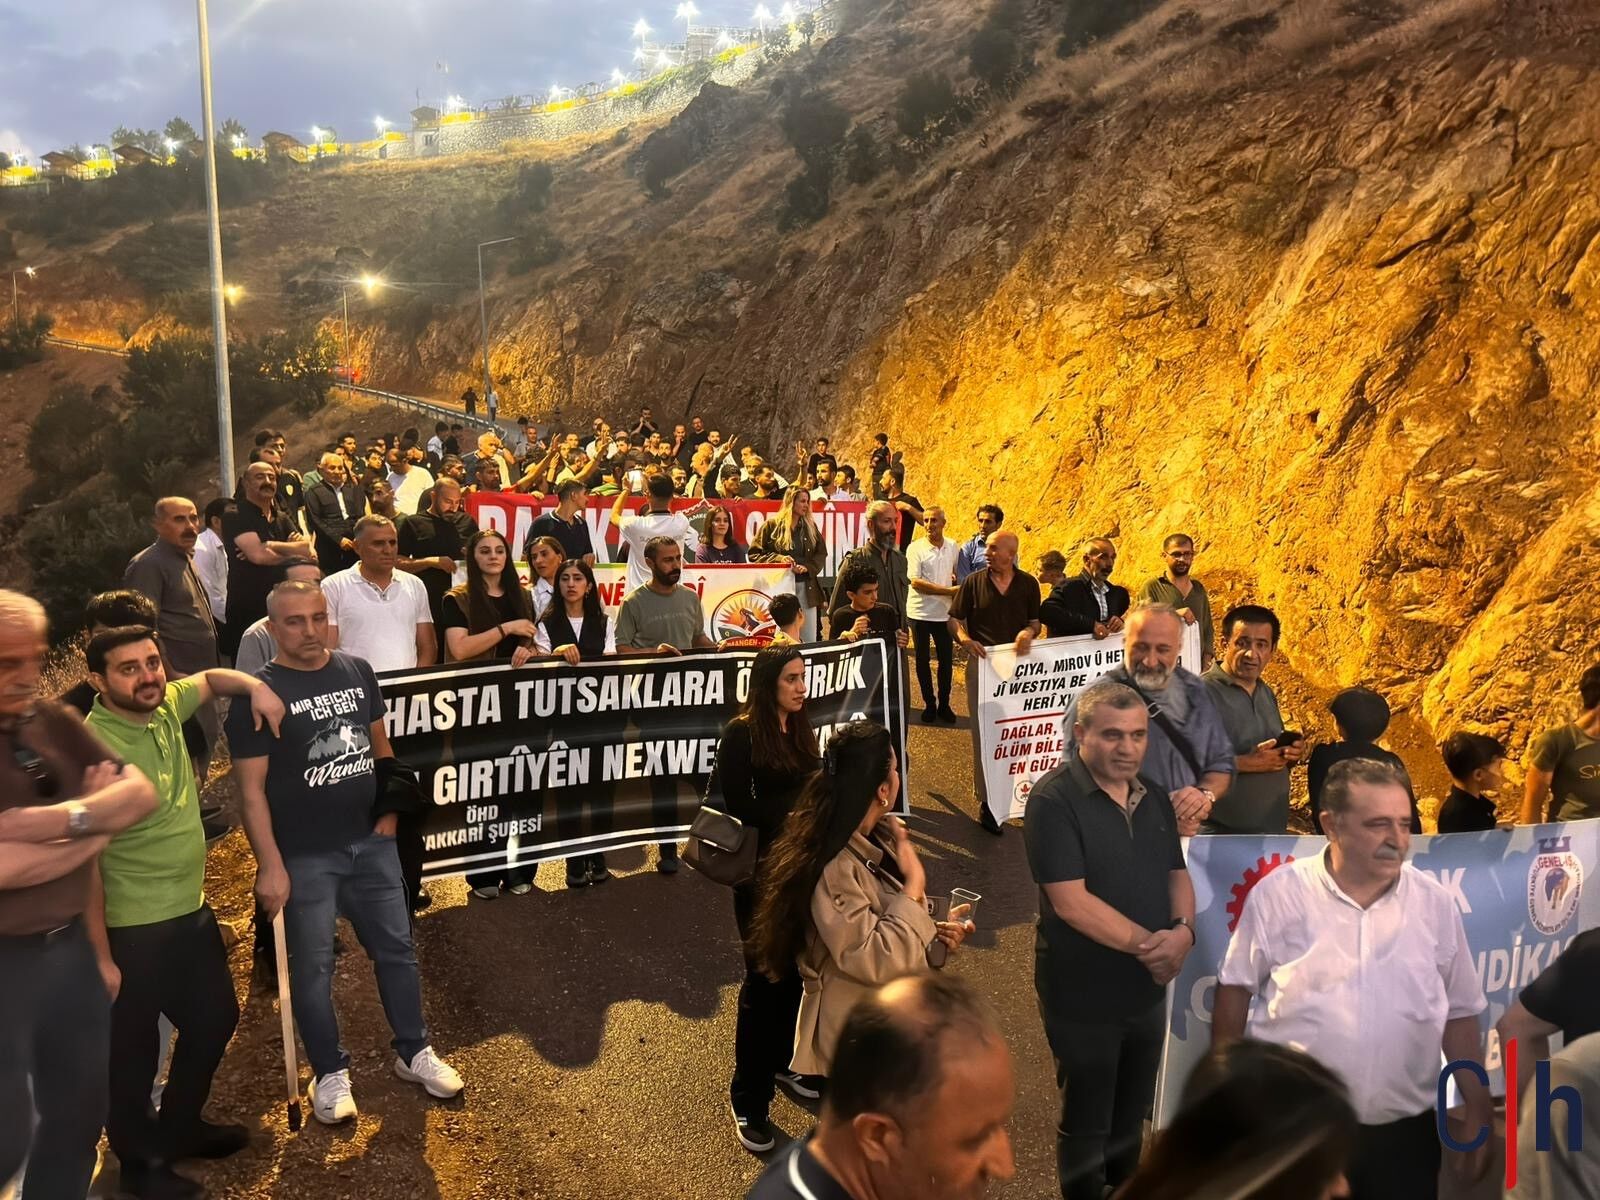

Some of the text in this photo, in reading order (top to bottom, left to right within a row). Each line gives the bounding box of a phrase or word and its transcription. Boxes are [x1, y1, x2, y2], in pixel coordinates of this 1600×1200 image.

[1015, 662, 1048, 679] ÇIYA,
[1053, 655, 1091, 672] MIROV
[1095, 650, 1102, 666] Û
[993, 681, 1007, 697] JÎ
[1009, 677, 1065, 695] WESTIYA
[290, 687, 365, 715] MIR REICHT'S
[310, 700, 358, 721] ICH GEH
[384, 683, 502, 738] HASTA
[515, 669, 725, 720] TUTSAKLARA
[1023, 693, 1057, 711] HERÎ
[1001, 722, 1057, 741] DAĞLAR,
[994, 737, 1064, 760] ÖLÜM BİLE
[433, 738, 721, 806] GIRTÎYÊN NEXWE
[1009, 755, 1061, 775] EN GÜZ
[467, 804, 498, 824] ÖHD
[422, 814, 541, 851] AKKARİ ŞUBESİ
